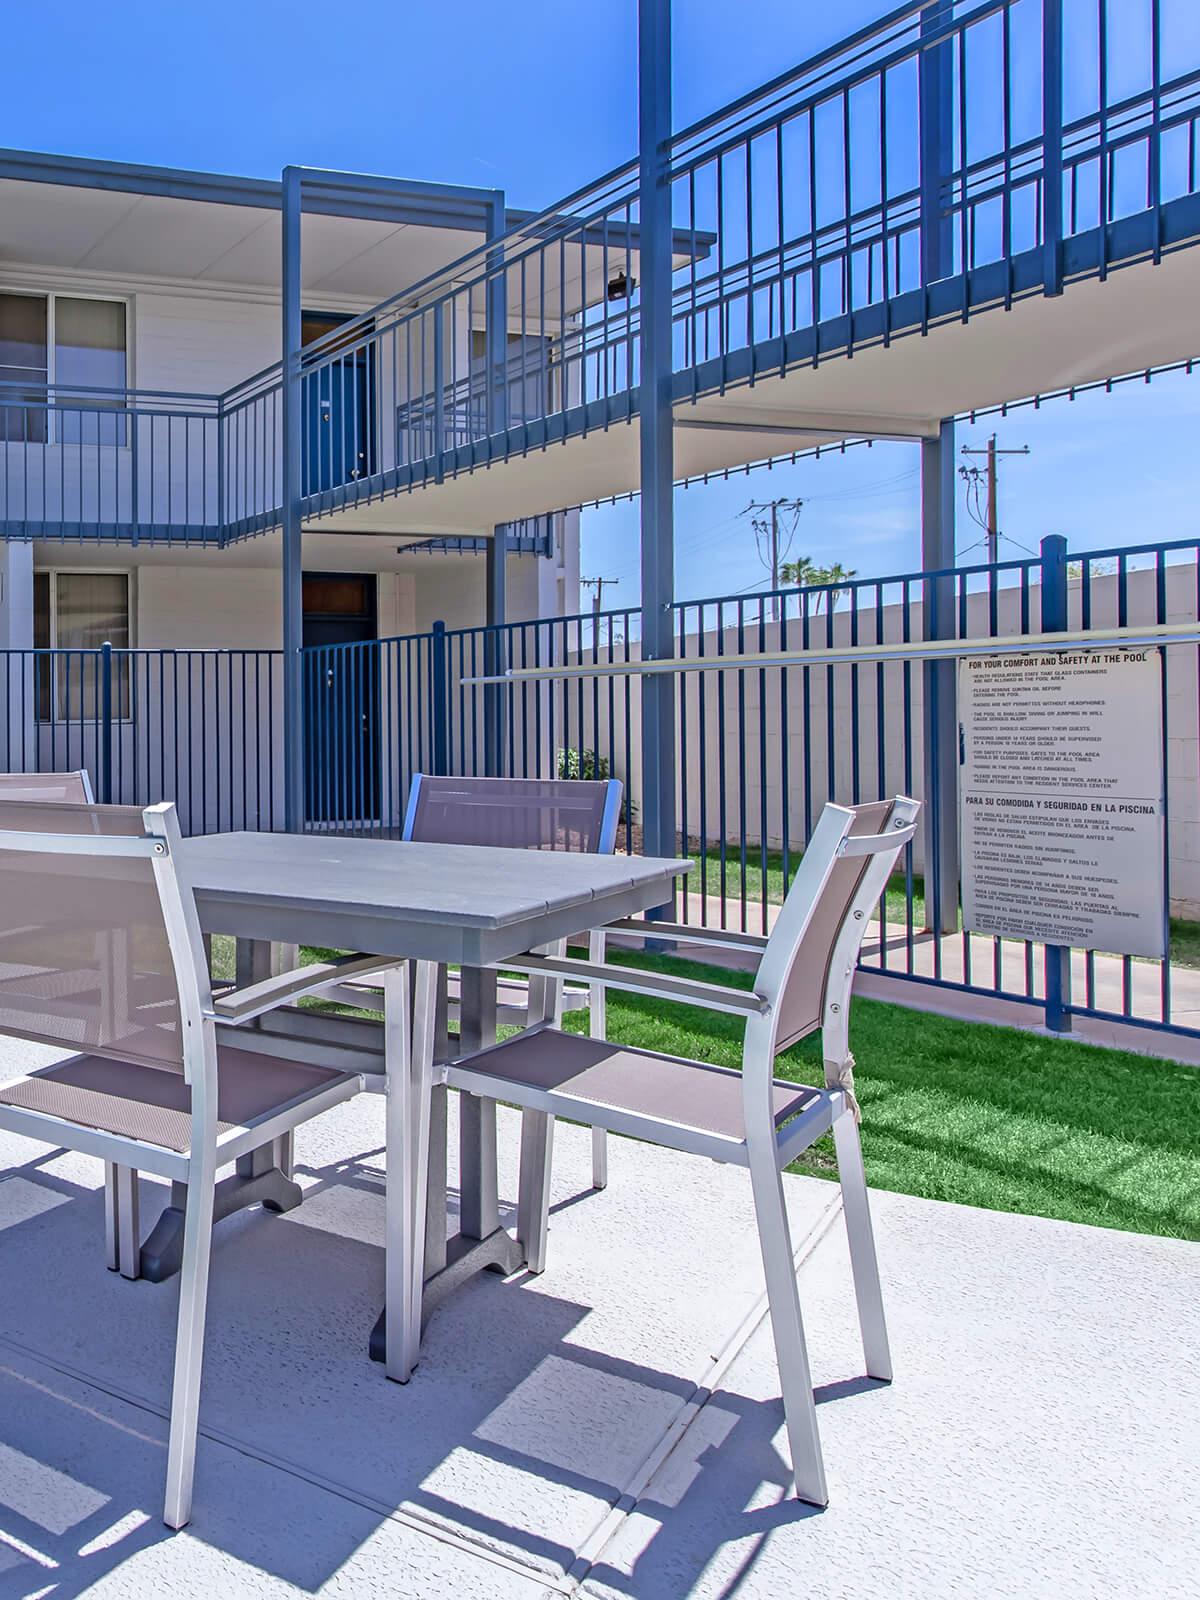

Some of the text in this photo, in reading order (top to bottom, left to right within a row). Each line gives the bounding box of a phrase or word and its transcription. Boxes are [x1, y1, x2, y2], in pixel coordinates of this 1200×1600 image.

[1004, 658, 1038, 667] COMFORT
[1040, 658, 1056, 666] AND
[1059, 656, 1088, 665] SAFETY
[1092, 656, 1101, 664] AT
[1104, 654, 1120, 663] THE
[1124, 653, 1147, 662] POOL
[966, 796, 1155, 814] PARA SU COMODIDA Y SEGURIDAD EN LA PISCINA
